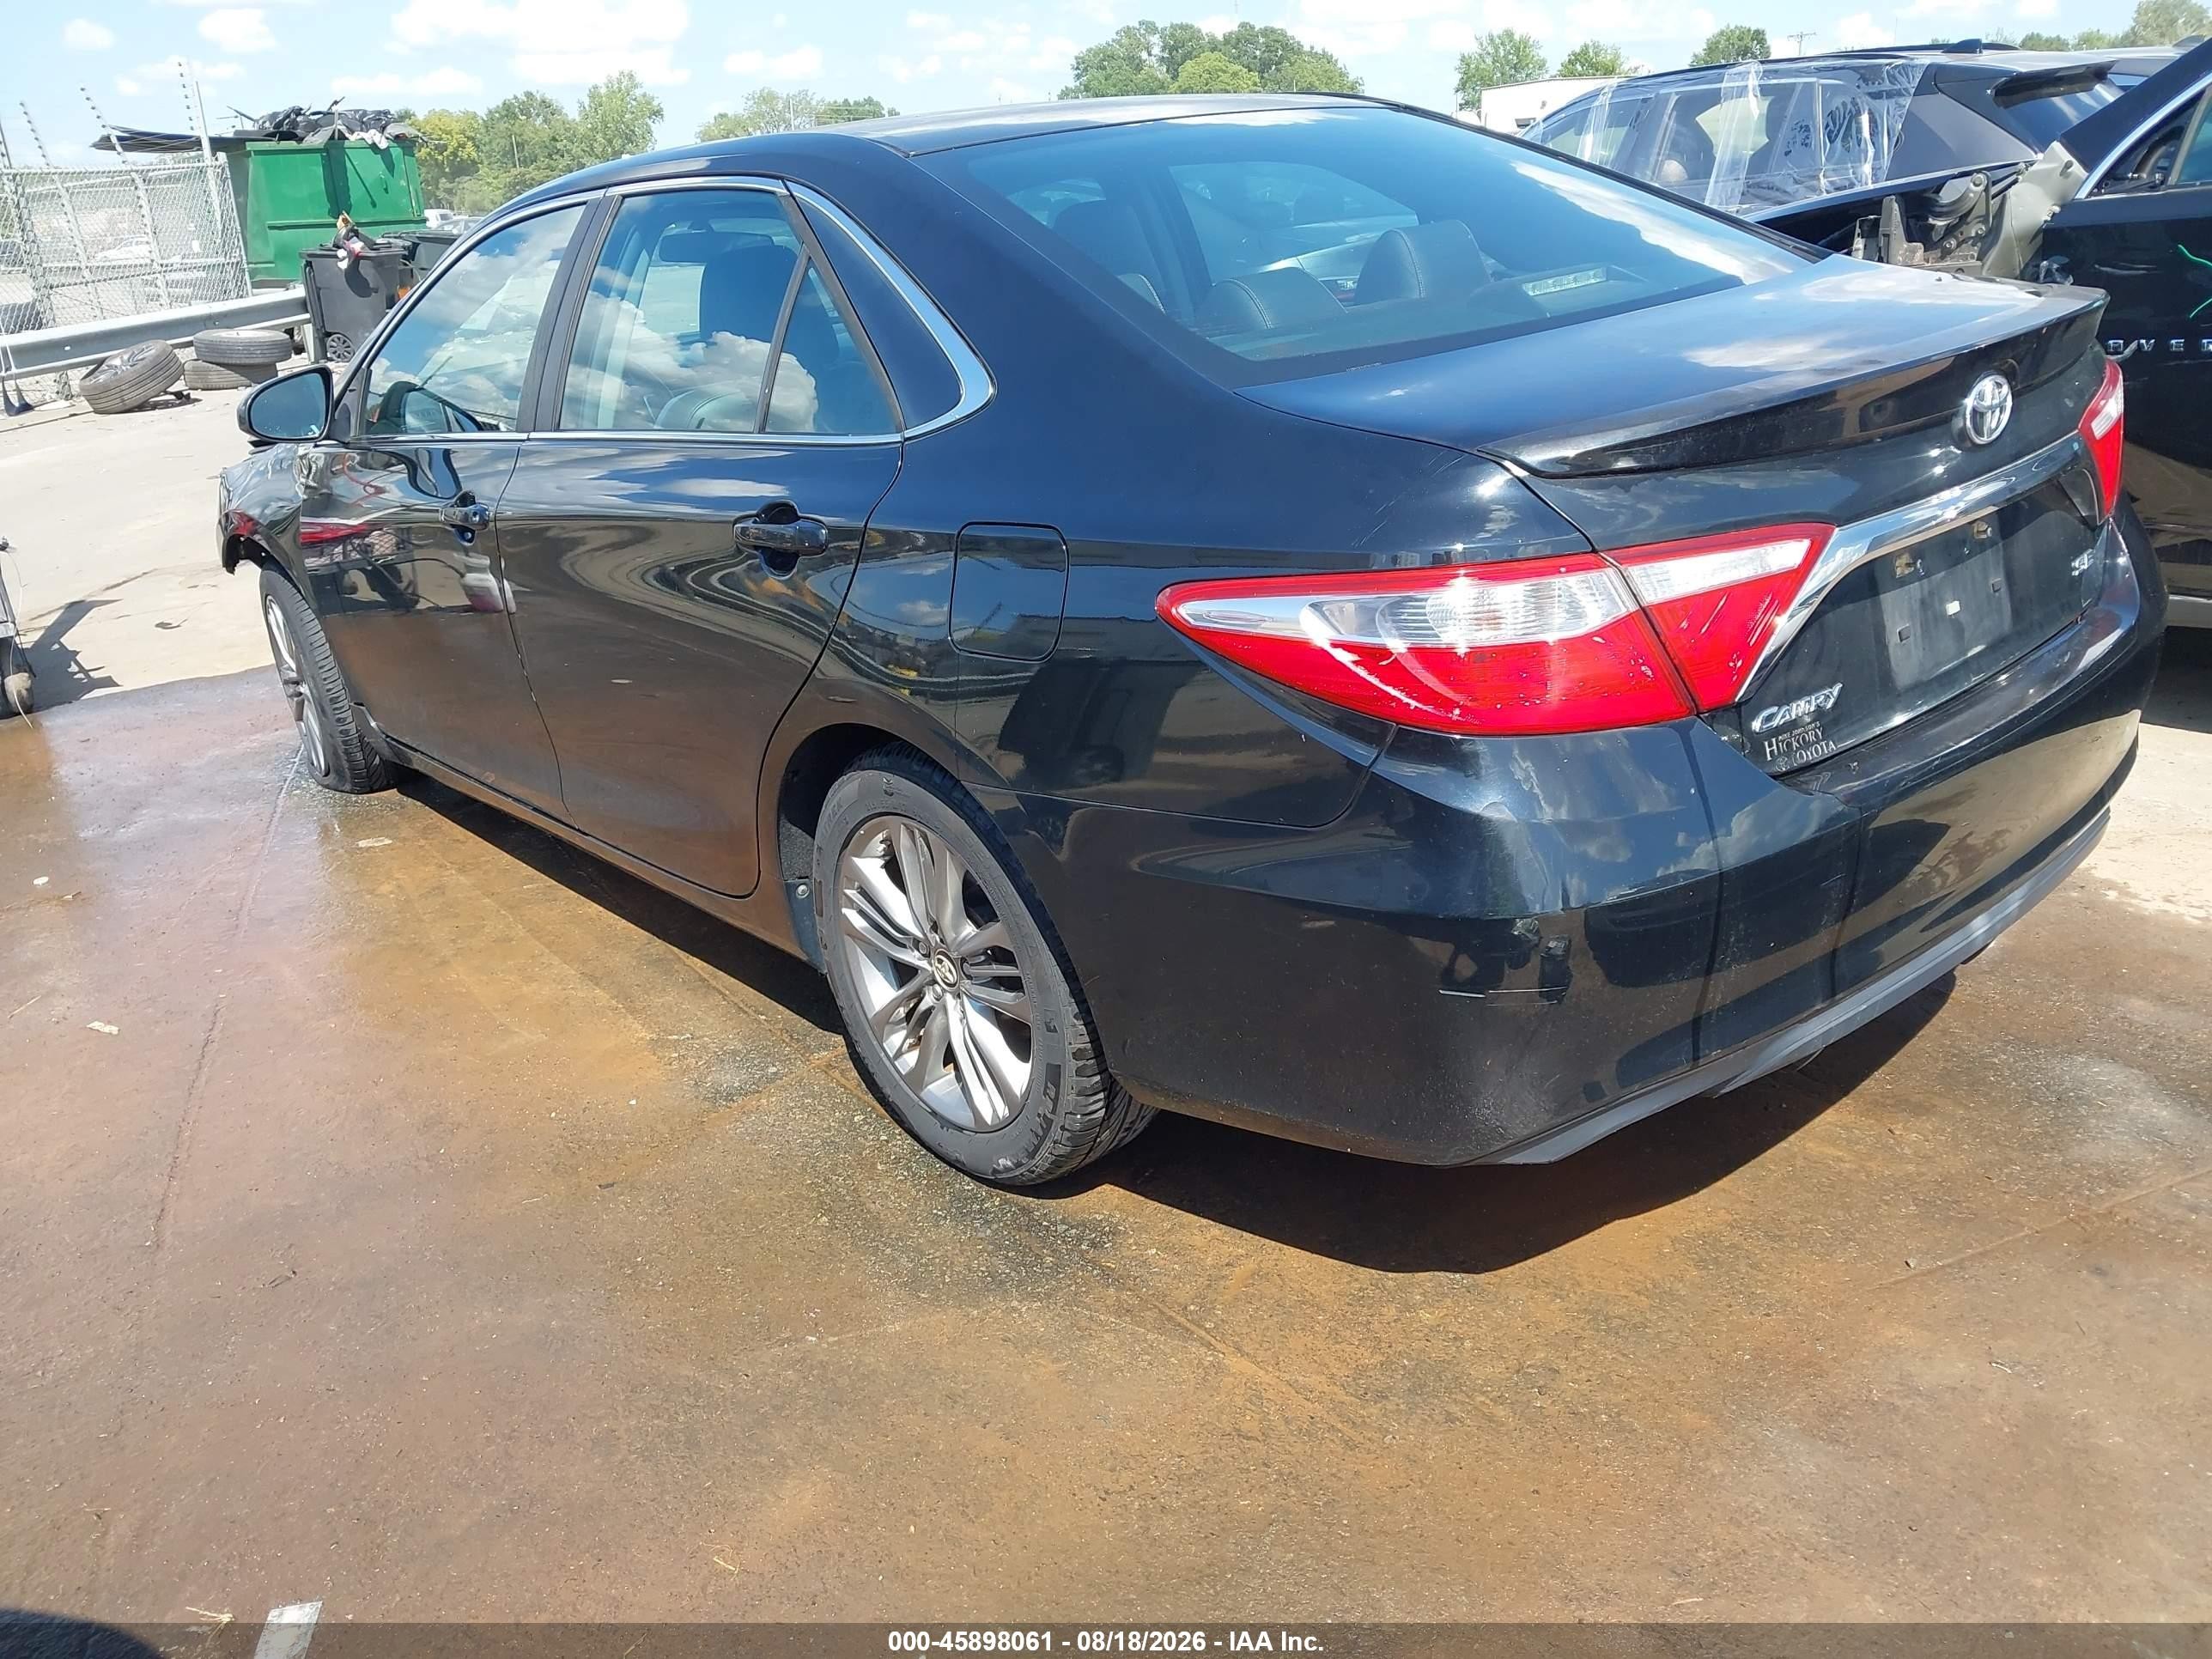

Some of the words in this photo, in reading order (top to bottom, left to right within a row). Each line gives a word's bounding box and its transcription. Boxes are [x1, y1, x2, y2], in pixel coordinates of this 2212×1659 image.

[1752, 683, 1843, 732] CAMRY
[1763, 726, 1824, 762] HICKORY
[1791, 740, 1837, 767] TOYOTA
